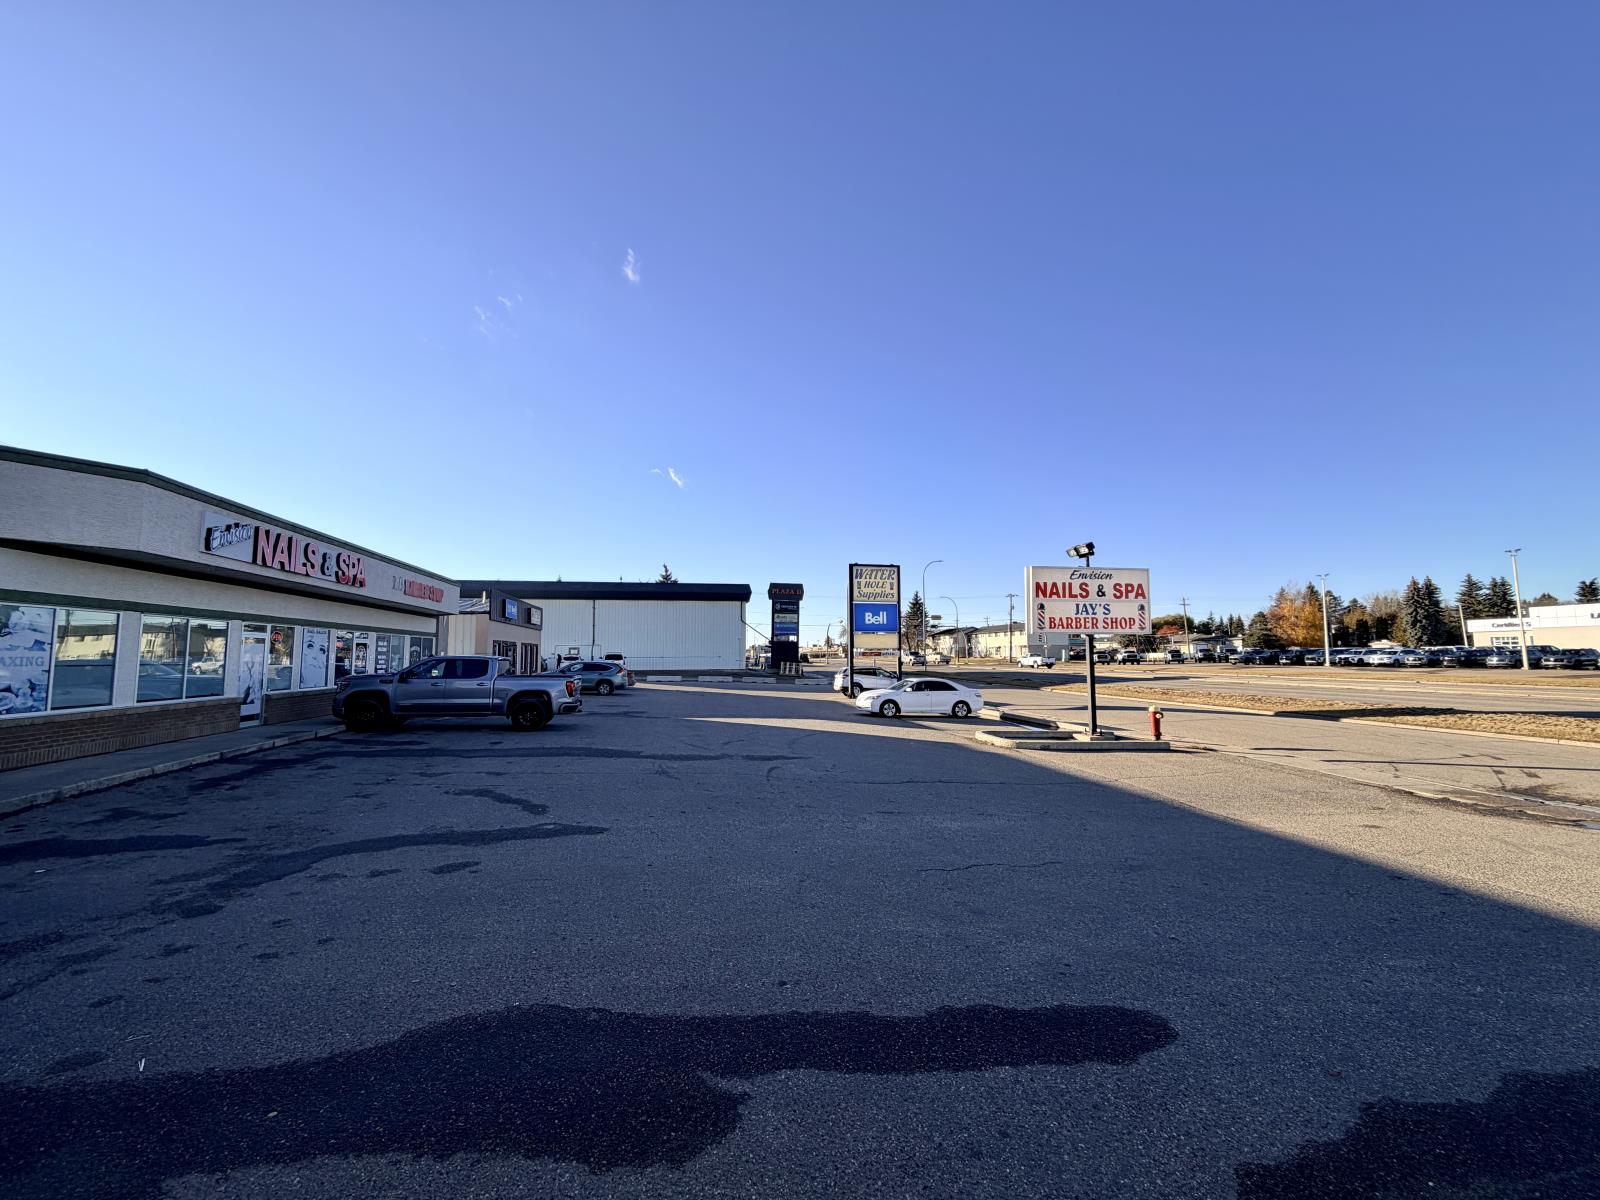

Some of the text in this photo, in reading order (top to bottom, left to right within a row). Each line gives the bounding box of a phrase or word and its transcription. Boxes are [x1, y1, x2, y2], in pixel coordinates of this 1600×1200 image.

[206, 523, 252, 551] Envision
[254, 526, 319, 577] NAILS
[323, 552, 333, 577] &
[336, 553, 366, 588] SPA
[854, 568, 896, 580] WATER
[1069, 569, 1114, 581] Envision
[864, 580, 887, 589] HOLE
[1035, 582, 1147, 599] NAILS & SPA
[857, 590, 895, 600] Supplies
[1074, 603, 1111, 616] JAY'S
[864, 611, 887, 625] Bell
[1048, 616, 1136, 630] BARBER SHOP
